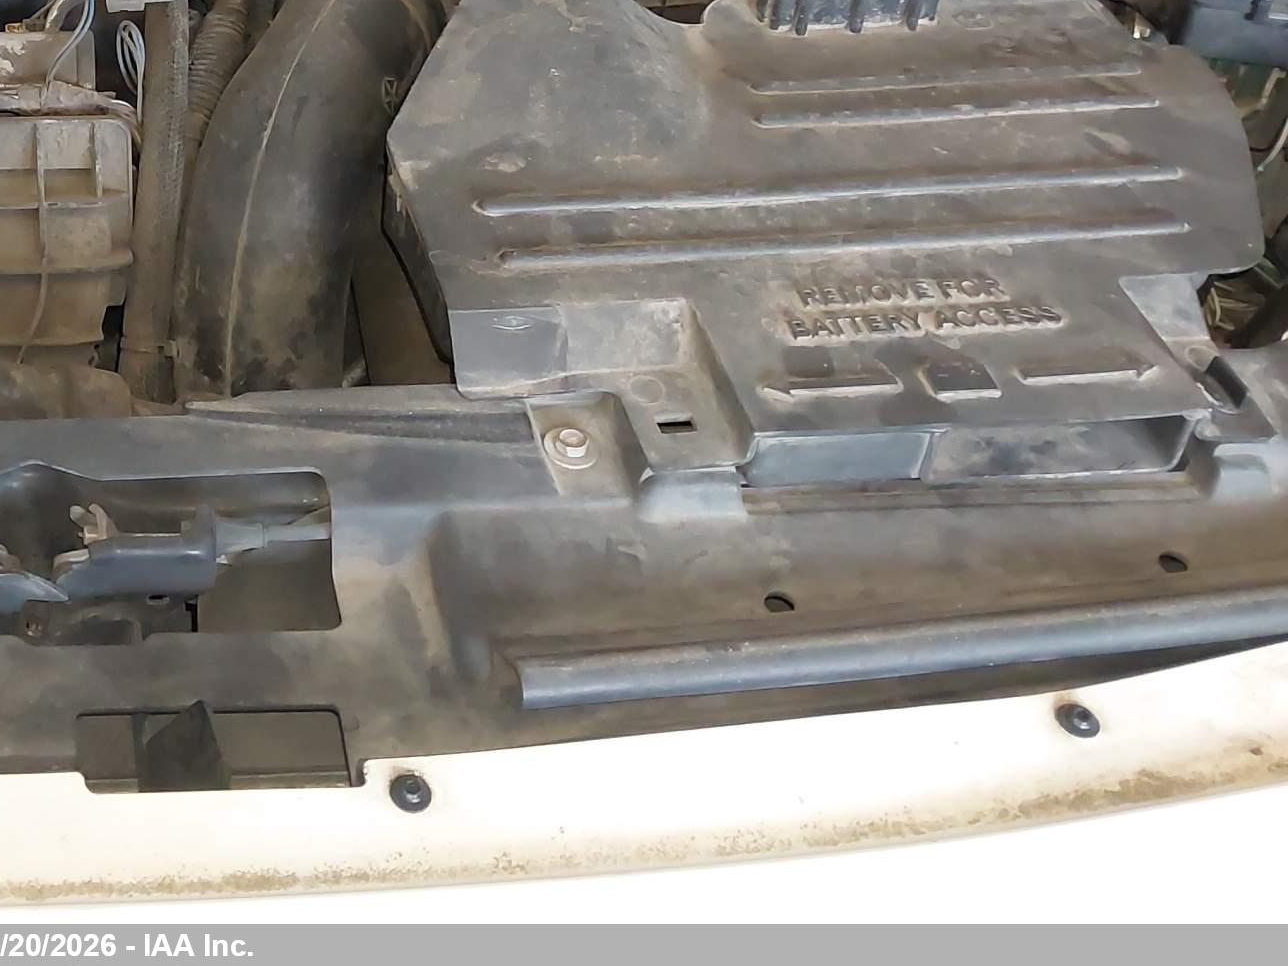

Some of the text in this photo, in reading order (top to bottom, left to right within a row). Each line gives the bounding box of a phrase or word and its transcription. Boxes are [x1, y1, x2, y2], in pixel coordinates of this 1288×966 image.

[796, 276, 1011, 309] REMOVE FOR
[785, 305, 1066, 342] BATTERY ACCESS
